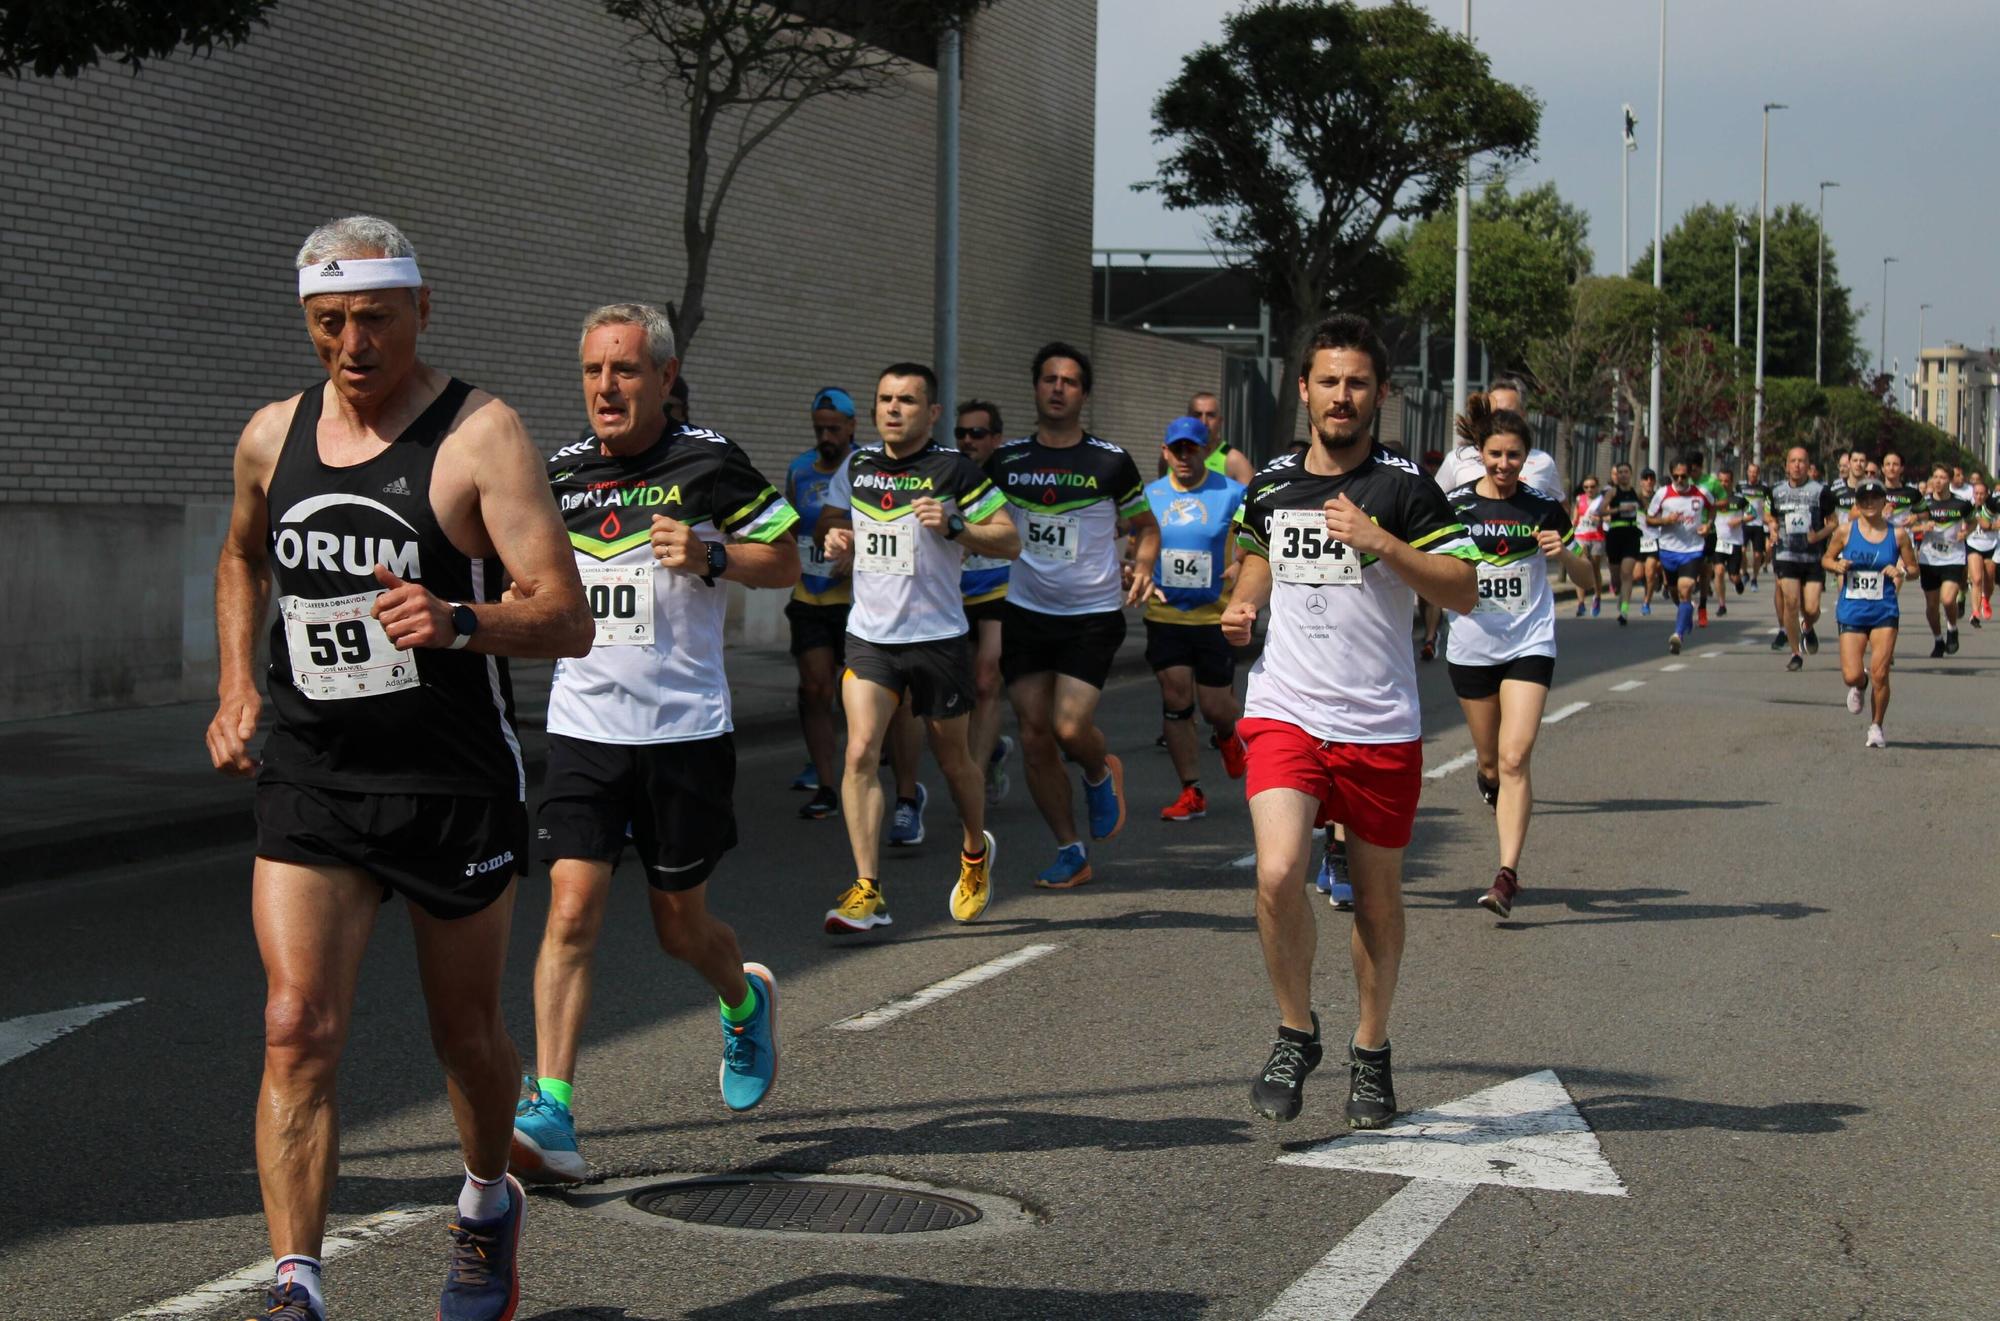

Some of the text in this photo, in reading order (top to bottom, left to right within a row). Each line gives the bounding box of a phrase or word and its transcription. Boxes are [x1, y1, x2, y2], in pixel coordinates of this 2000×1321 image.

[382, 486, 411, 496] adidas
[853, 475, 934, 490] DONAVIDA
[1007, 472, 1098, 489] DONAVIDA
[561, 484, 683, 511] DONAVIDA
[867, 533, 897, 557] 311
[1029, 522, 1066, 547] 541
[1282, 527, 1346, 560] 354
[273, 528, 422, 580] ORUM
[809, 545, 833, 563] 10
[1174, 558, 1198, 576] 94
[1478, 577, 1522, 599] 389
[1852, 576, 1878, 590] 592
[330, 595, 367, 608] DONAVIDA
[583, 585, 636, 619] 00
[305, 619, 372, 667] 59
[322, 664, 364, 673] JOSÉ MANUEL
[465, 850, 514, 877] Joma
